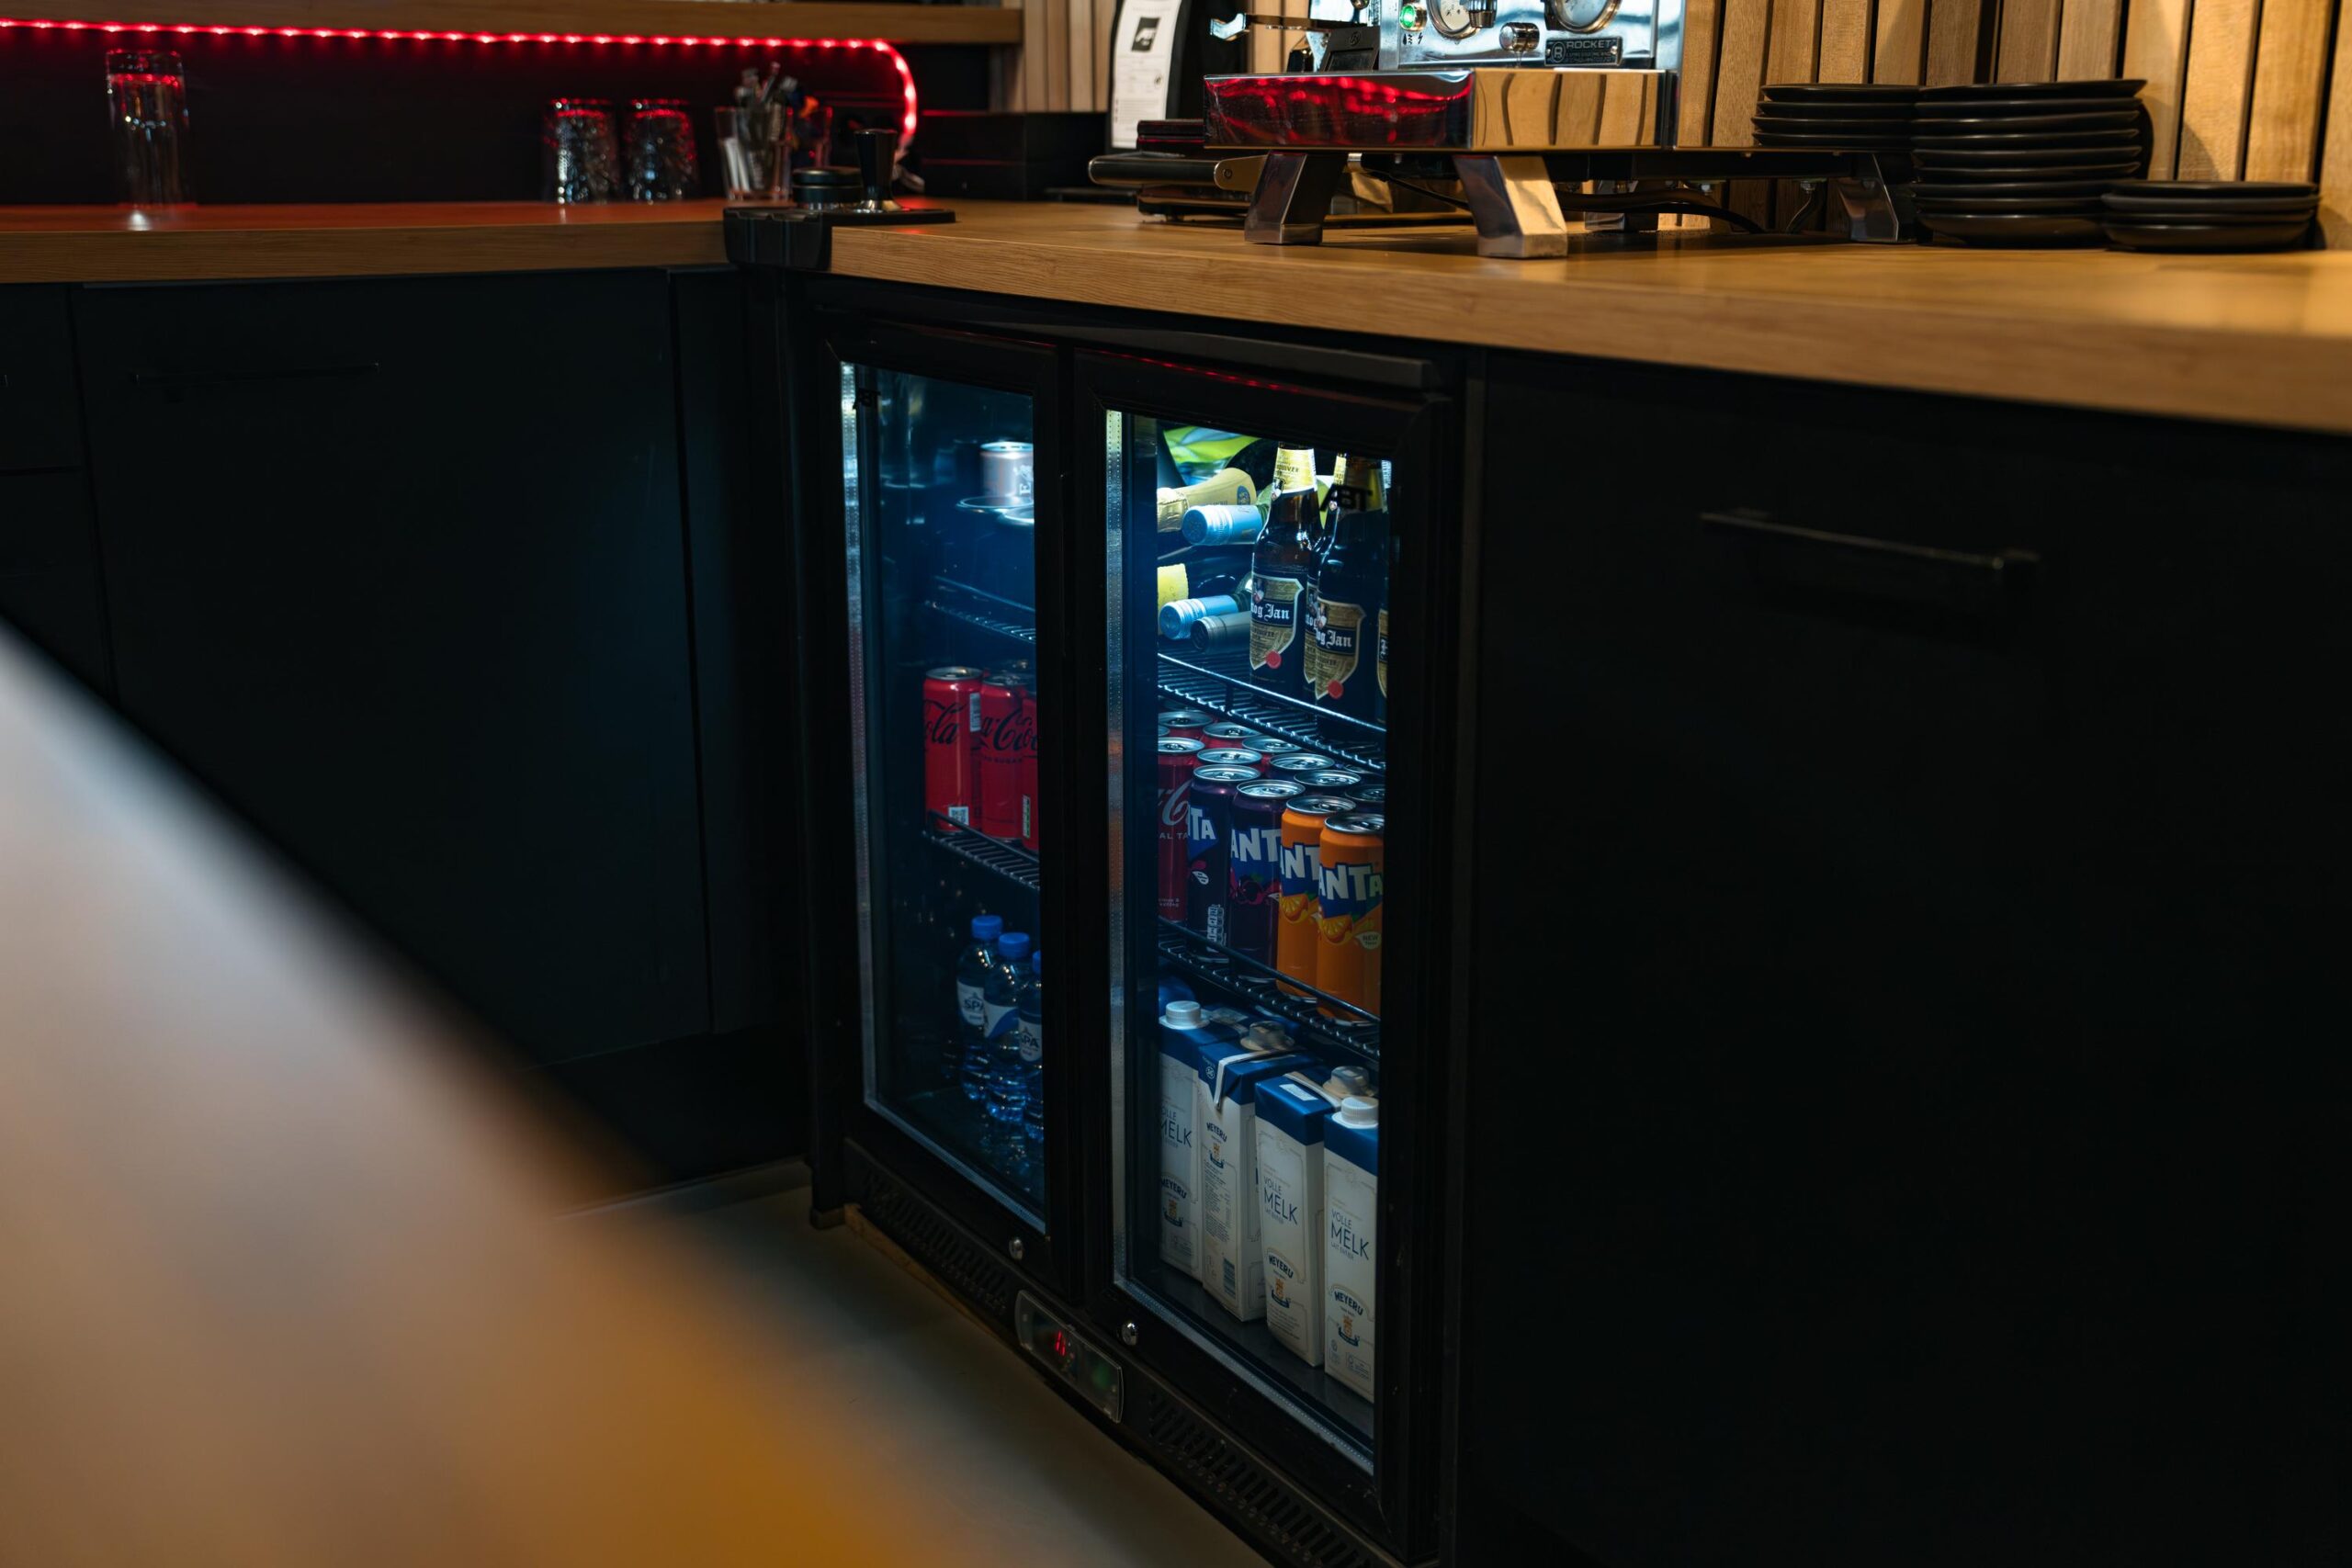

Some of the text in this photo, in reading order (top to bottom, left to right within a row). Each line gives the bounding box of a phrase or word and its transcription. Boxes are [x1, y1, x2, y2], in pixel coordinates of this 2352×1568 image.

[1566, 39, 1612, 50] ROCKET
[1263, 603, 1290, 622] Jan
[1325, 629, 1352, 649] Jan
[1187, 805, 1216, 840] TA
[1318, 864, 1383, 901] ANTA
[1263, 1176, 1283, 1196] VOLLE
[1263, 1187, 1298, 1225] MELK
[1331, 1208, 1352, 1229] VOLLE
[1330, 1221, 1369, 1260] MELK
